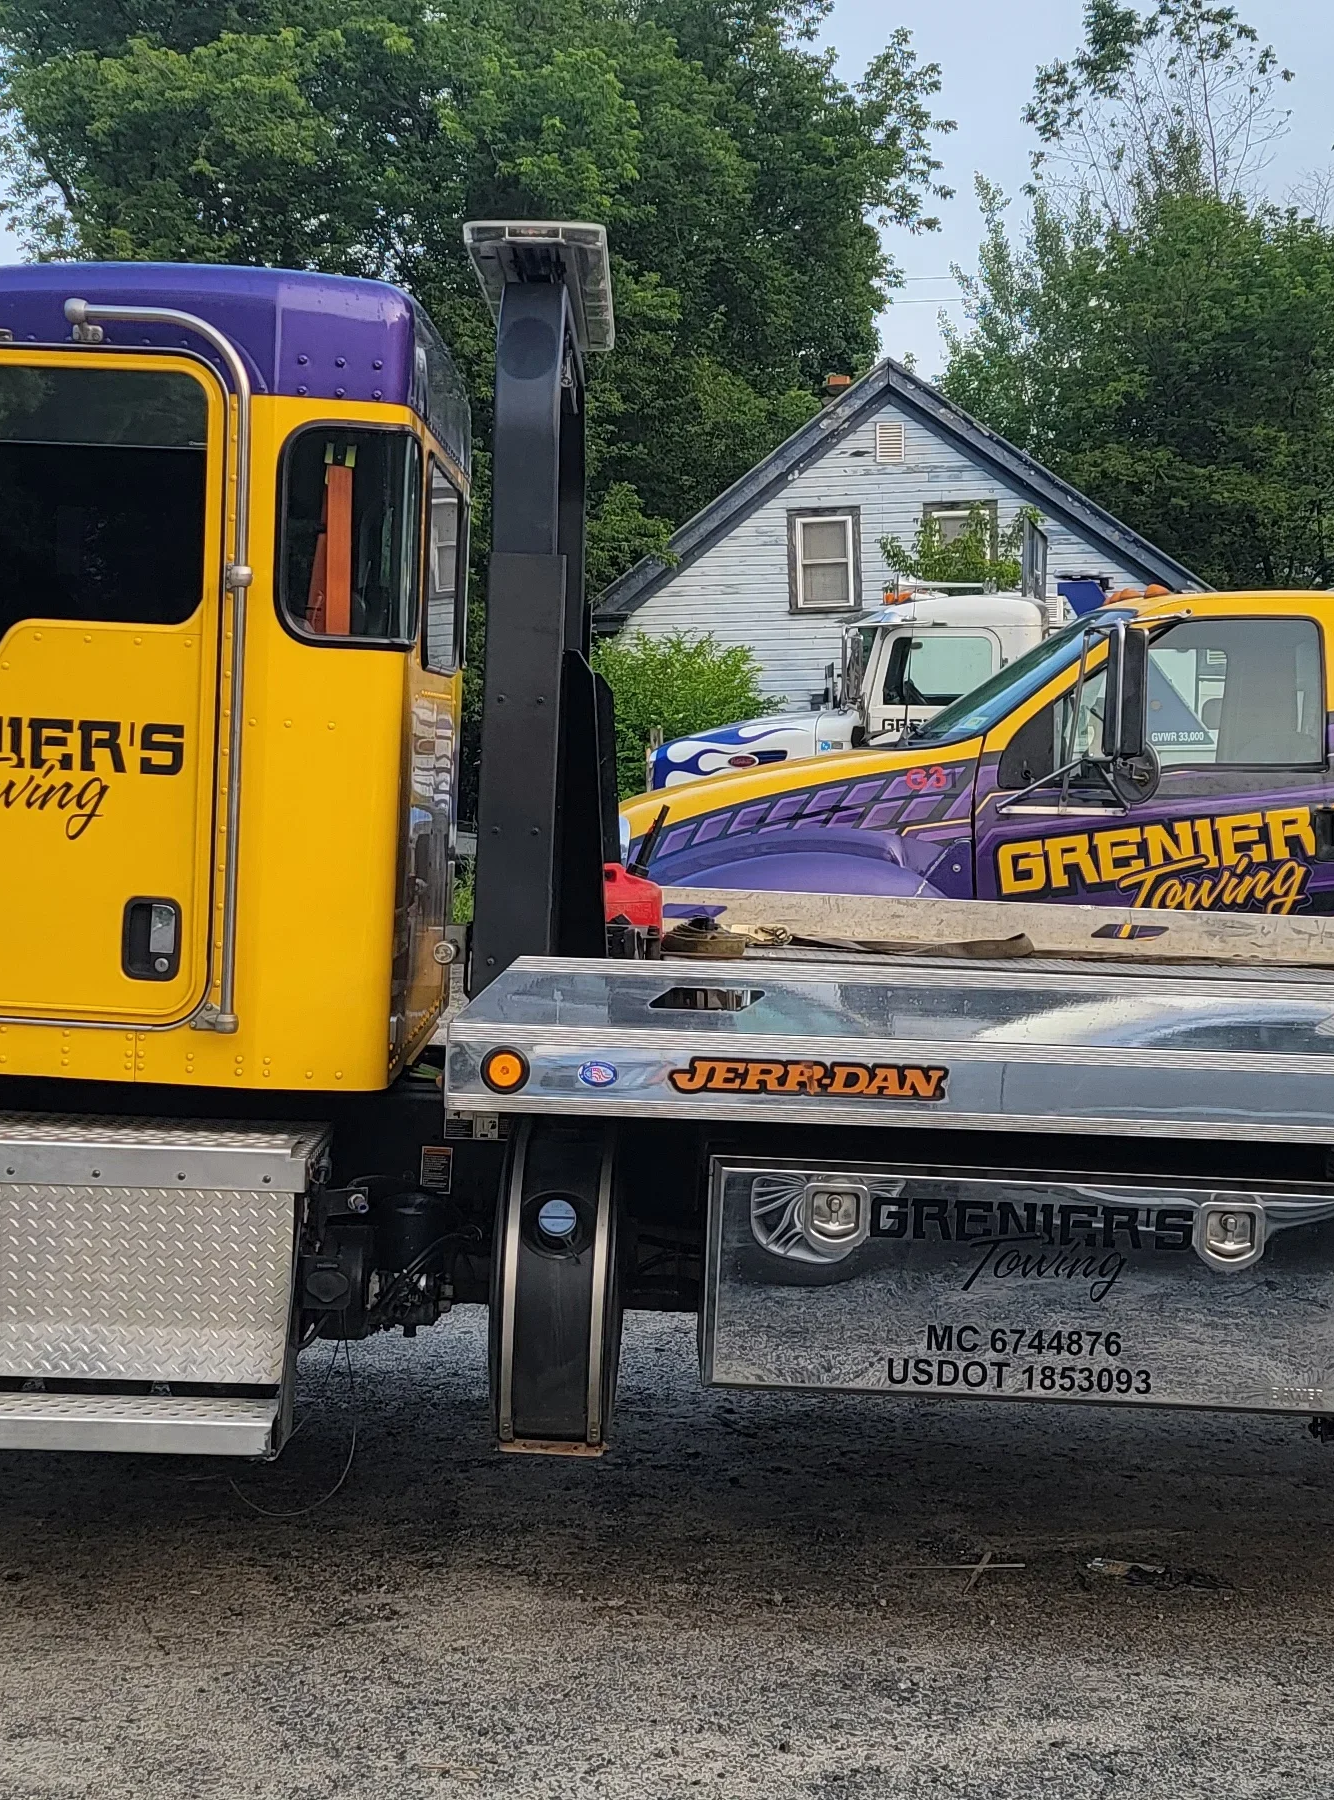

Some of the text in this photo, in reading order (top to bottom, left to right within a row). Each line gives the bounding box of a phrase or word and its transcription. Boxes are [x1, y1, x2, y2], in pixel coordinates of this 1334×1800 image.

[1151, 731, 1204, 742] GVWR 33,000
[1117, 852, 1308, 915] Towing
[671, 1059, 946, 1098] JERR-DAN
[869, 1196, 1195, 1251] GRENIER'S
[960, 1231, 1128, 1302] Towing
[925, 1324, 1123, 1357] MC 6744876
[886, 1357, 1152, 1395] USDOT 1853093
